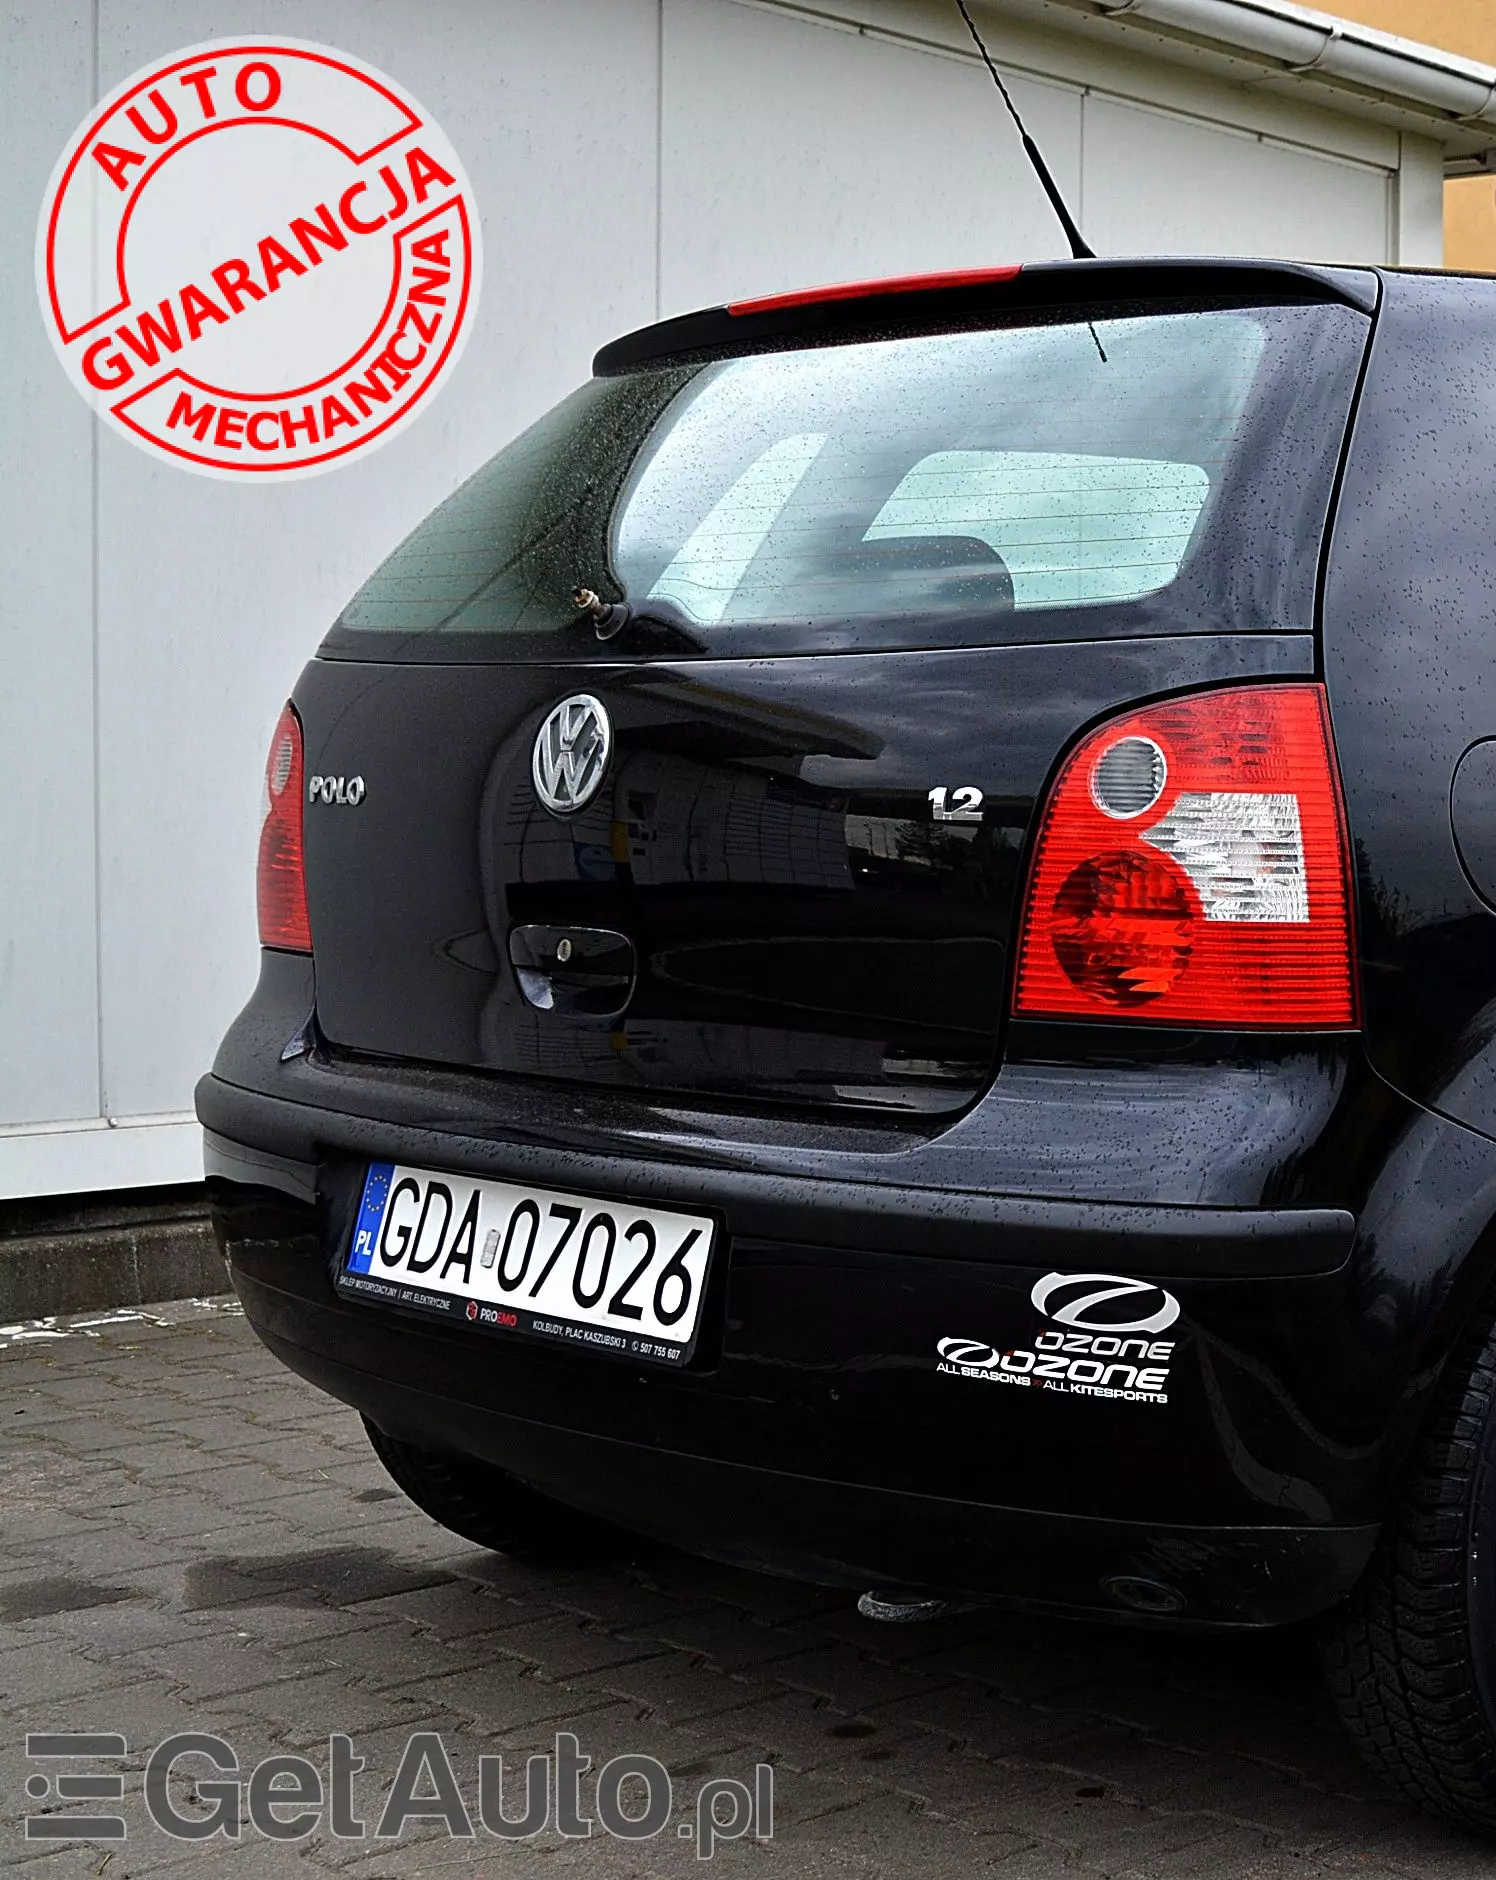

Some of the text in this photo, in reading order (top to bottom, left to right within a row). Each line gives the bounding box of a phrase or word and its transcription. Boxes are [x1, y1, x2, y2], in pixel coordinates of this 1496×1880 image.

[309, 775, 365, 805] POLO
[354, 1230, 371, 1255] PL
[380, 1177, 704, 1327] GDA 07026
[340, 1275, 355, 1287] SKLEP
[480, 1308, 517, 1326] PROEMO
[532, 1320, 627, 1349] KOLBUDY, PLAC KASZUBSKI 3
[1035, 1331, 1175, 1360] OZONE
[640, 1342, 681, 1360] 507 755 607
[936, 1362, 1168, 1403] ALL SEASONS ALL KITESPORTS
[1000, 1350, 1170, 1390] OZONE
